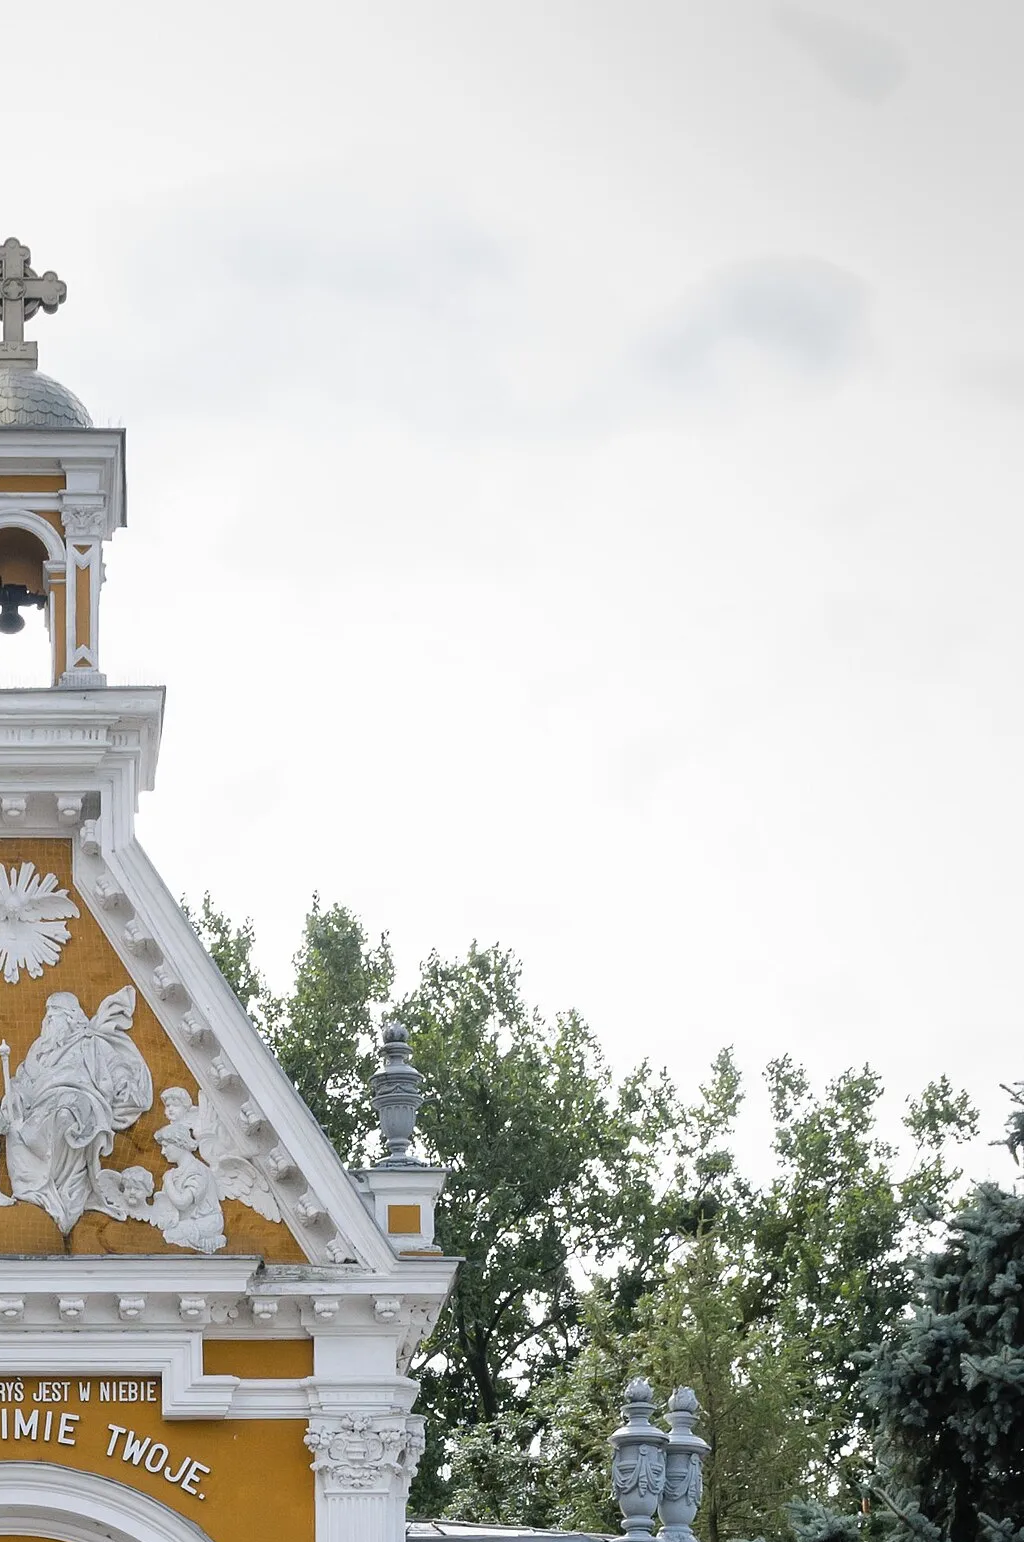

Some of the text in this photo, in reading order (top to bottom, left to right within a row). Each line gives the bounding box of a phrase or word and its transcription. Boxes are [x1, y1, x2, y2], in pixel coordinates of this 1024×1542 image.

[32, 1381, 71, 1402] JEST
[78, 1381, 91, 1402] W
[99, 1381, 157, 1402] NIEBIE
[0, 1408, 80, 1446] IMIE
[106, 1423, 211, 1500] TWOJE.
